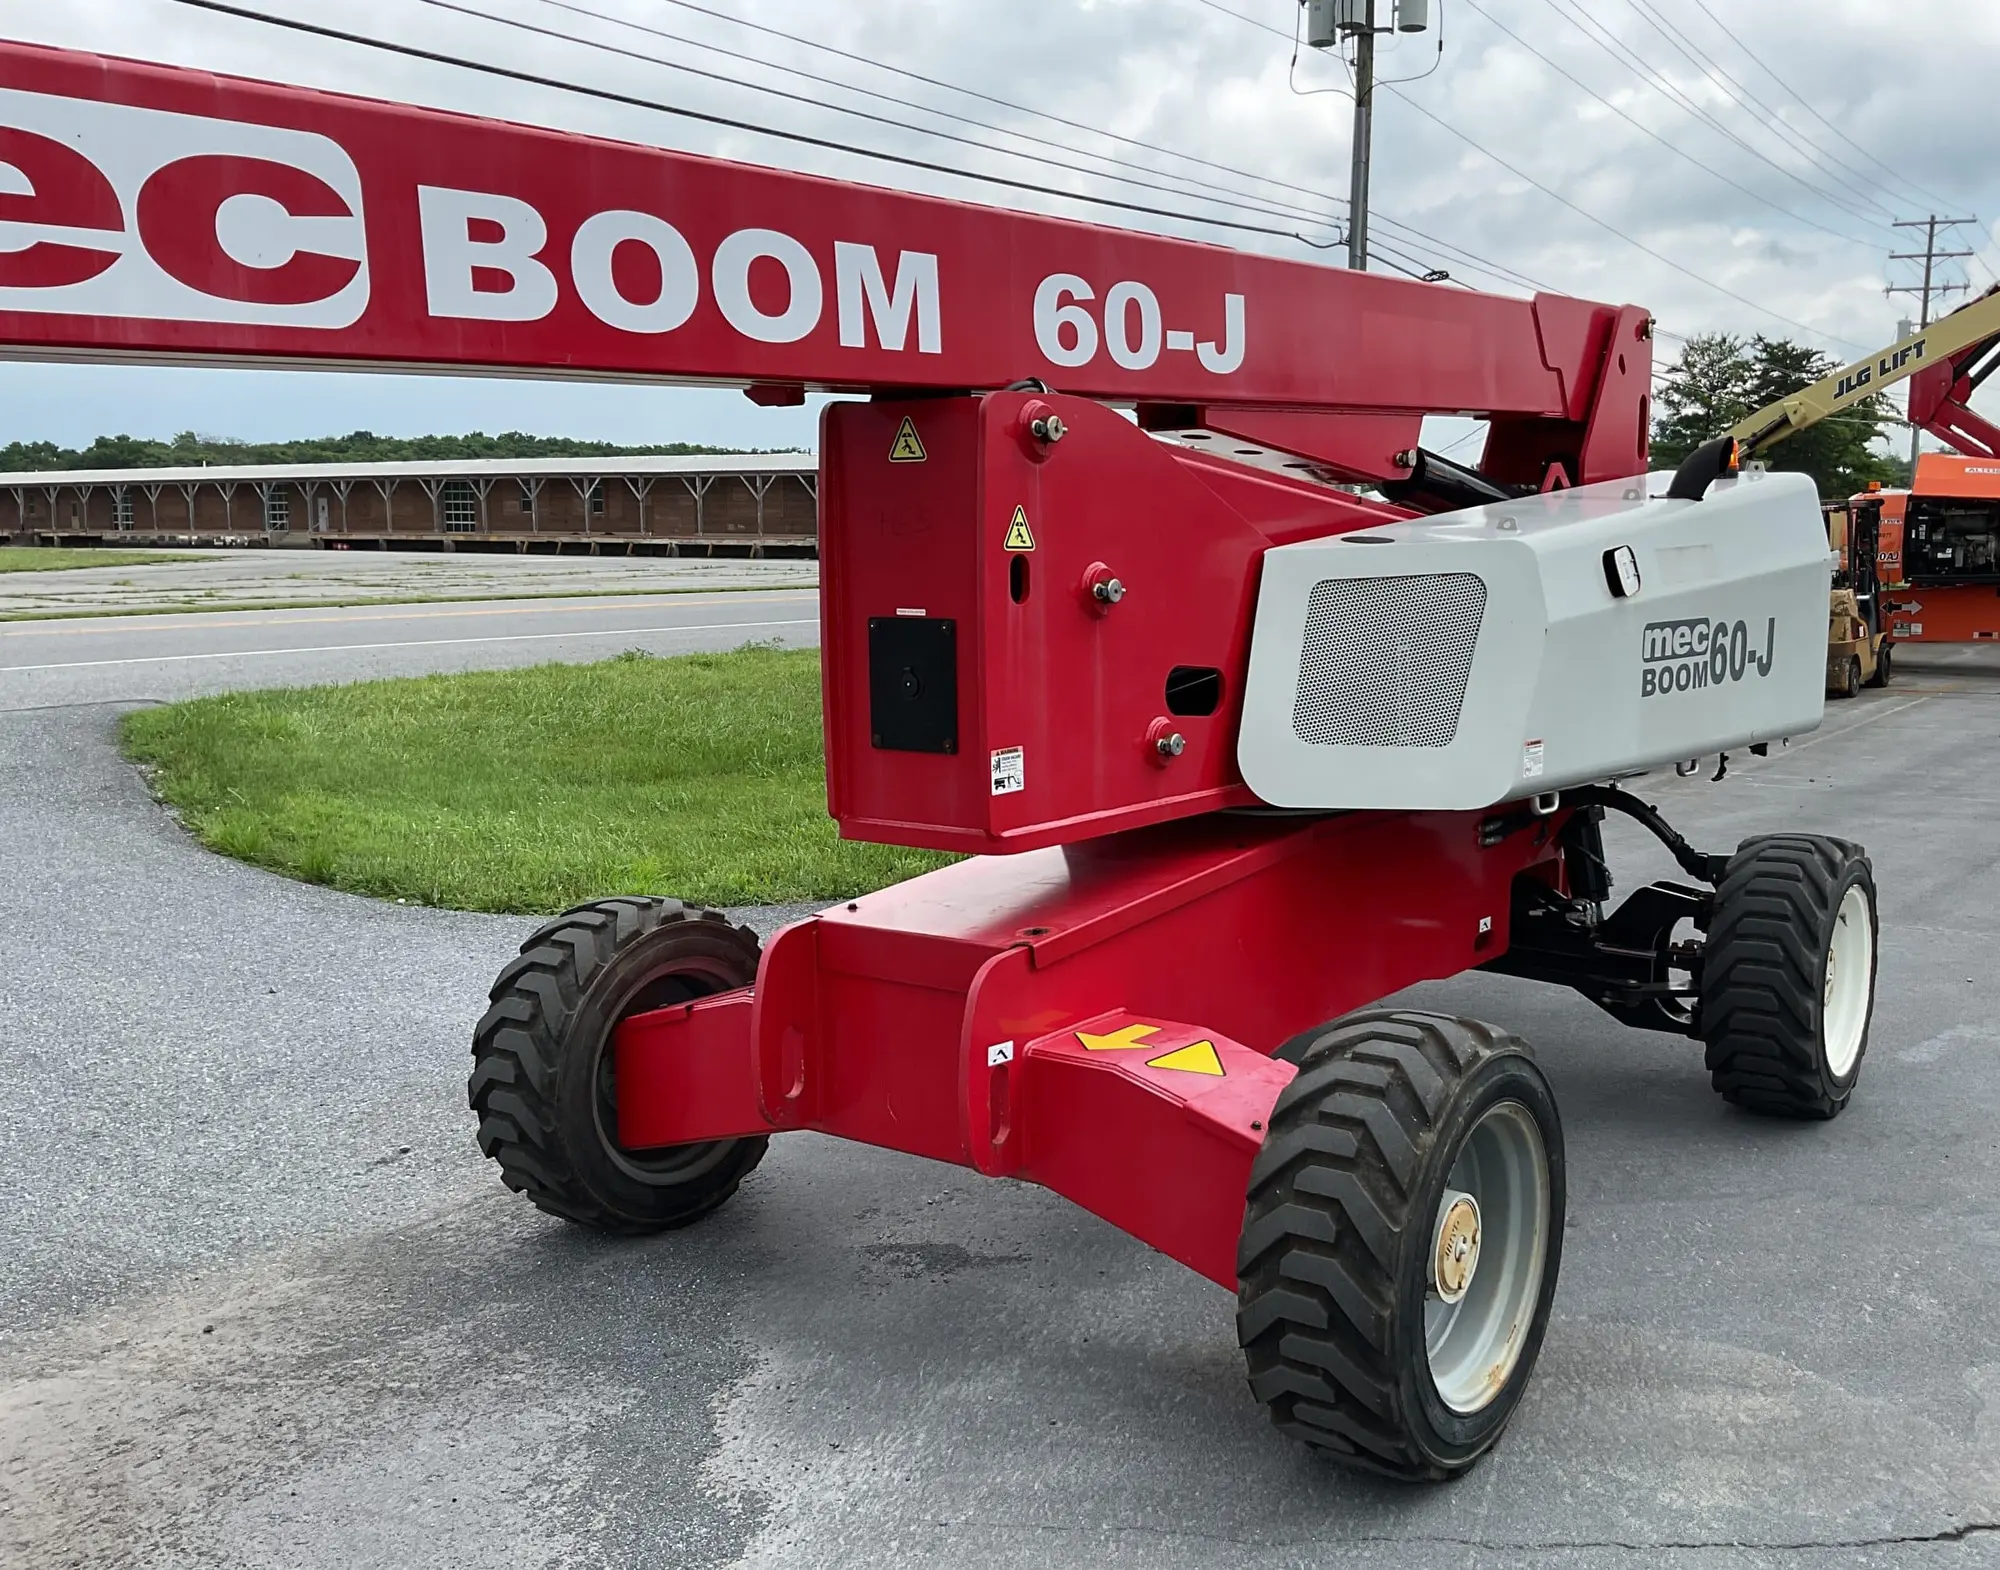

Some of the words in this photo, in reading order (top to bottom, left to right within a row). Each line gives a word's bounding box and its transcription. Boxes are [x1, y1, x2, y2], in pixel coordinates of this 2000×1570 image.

[417, 184, 943, 356] BOOM
[1032, 272, 1247, 375] 60-J
[1833, 365, 1871, 400] JLG
[1879, 338, 1926, 377] LIFT
[1876, 550, 1899, 562] 0AJ
[1643, 623, 1709, 659] mec
[1709, 617, 1776, 685] 60-J
[1641, 660, 1709, 698] BOOM
